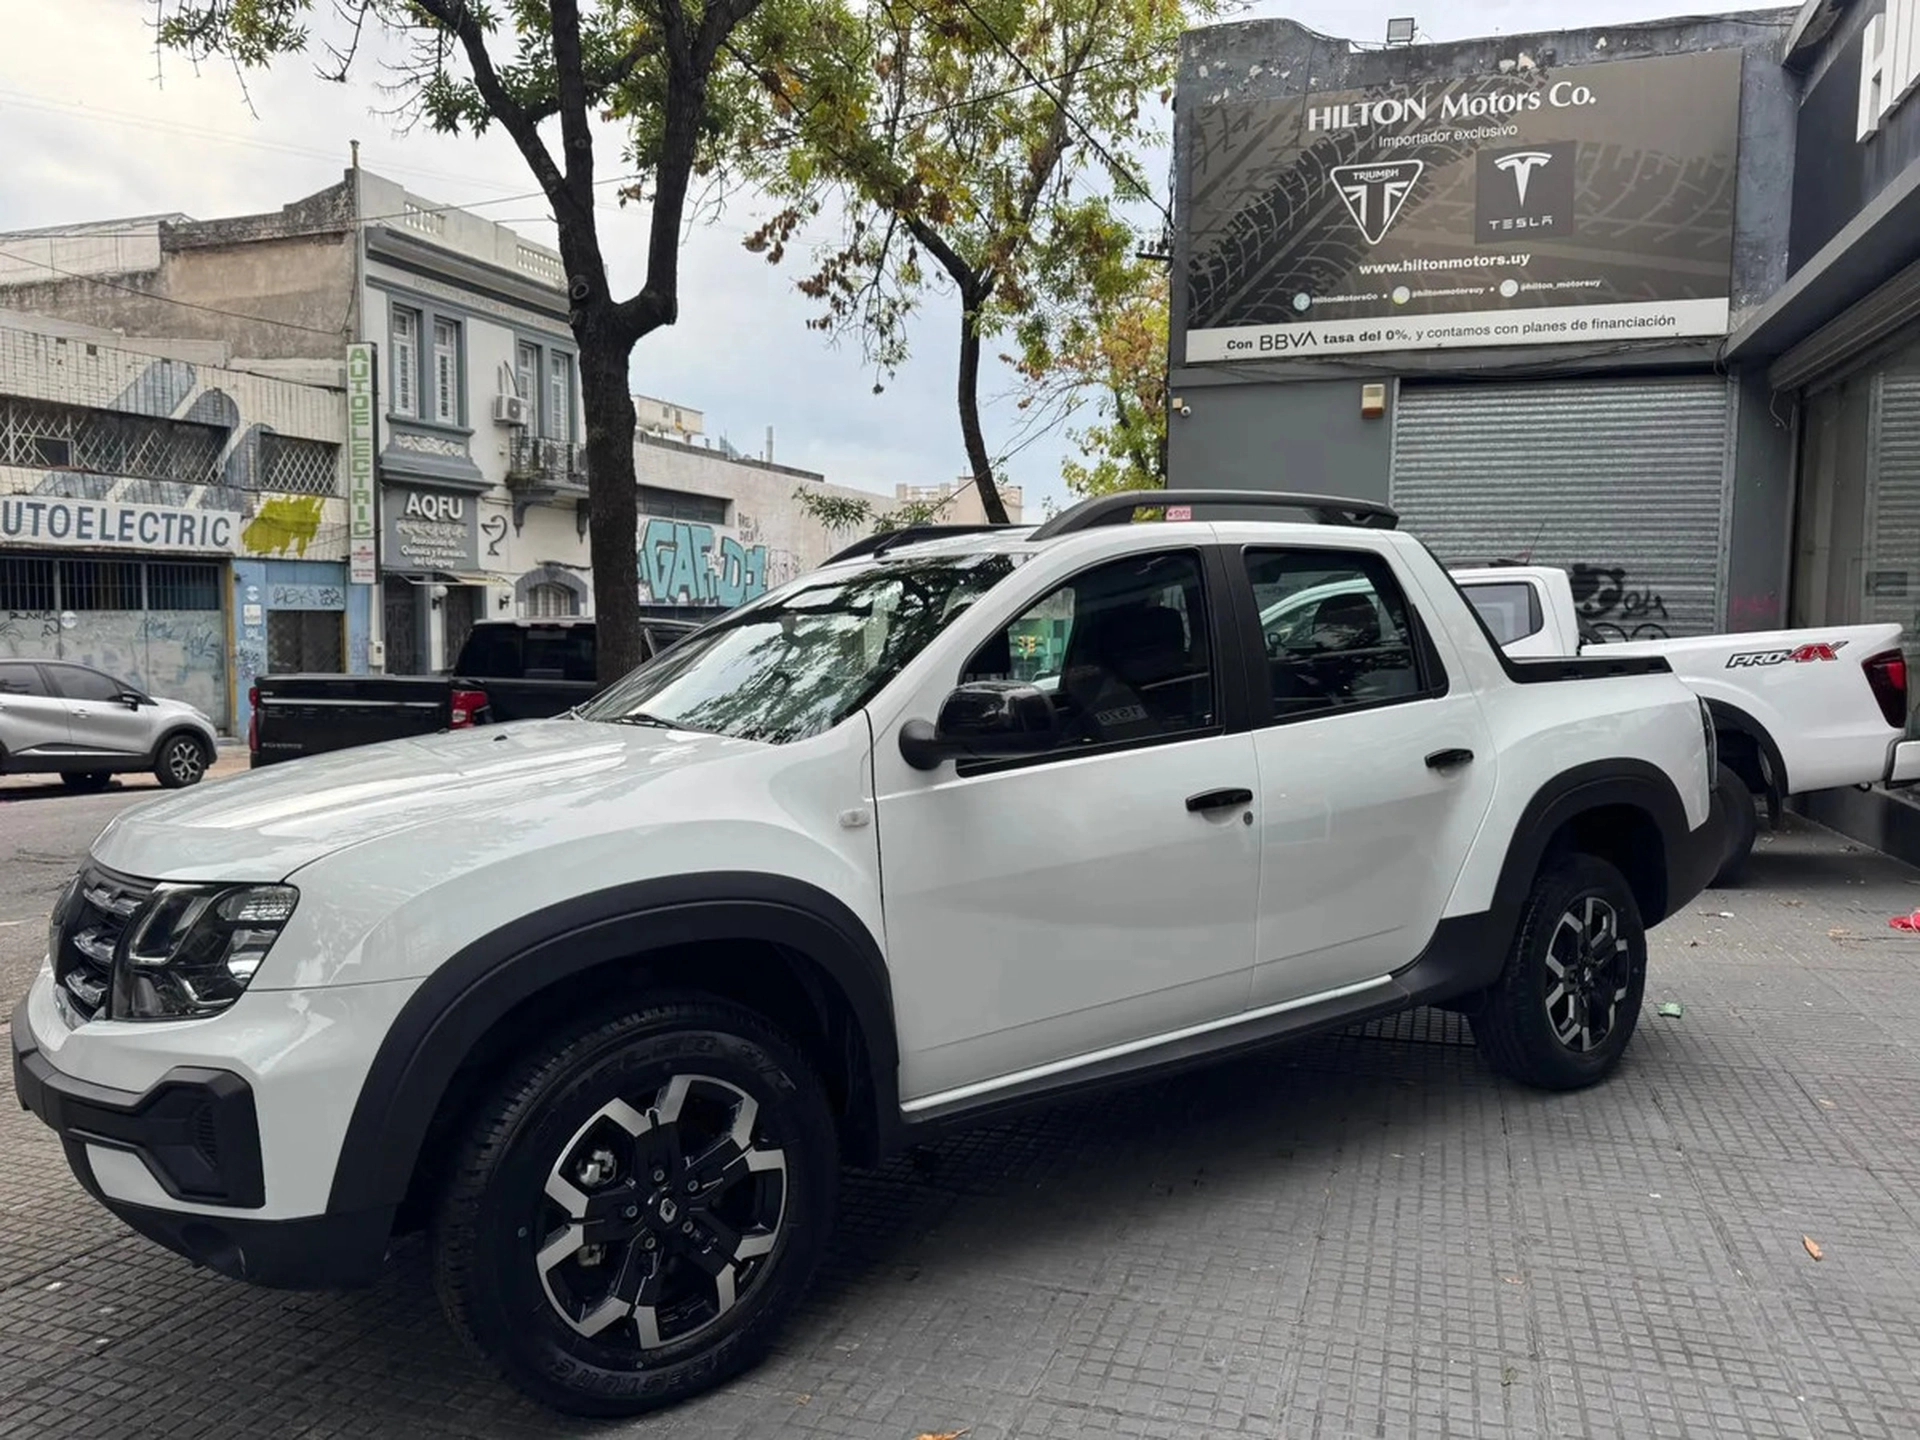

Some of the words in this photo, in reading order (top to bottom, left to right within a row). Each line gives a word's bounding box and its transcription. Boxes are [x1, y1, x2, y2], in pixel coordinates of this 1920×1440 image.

[1308, 97, 1426, 131] HILTON
[1440, 90, 1541, 119] Motors
[1549, 80, 1597, 107] Co.
[1378, 130, 1450, 149] Importador
[1454, 124, 1518, 141] exclusivo
[1353, 168, 1399, 181] TRIUMPH
[1489, 216, 1553, 230] TESLA
[1359, 252, 1531, 275] www.hiltonmotors.uy
[1226, 339, 1252, 351] Con
[1259, 330, 1318, 351] BBVA
[1323, 332, 1354, 344] tasa
[1359, 329, 1382, 342] del
[1386, 328, 1412, 341] 0%,
[1415, 330, 1424, 341] y
[1426, 323, 1490, 338] contamos
[1494, 321, 1519, 334] con
[1522, 316, 1567, 335] planes
[1570, 315, 1588, 331] de
[1591, 312, 1676, 330] financiación
[350, 348, 371, 536] AUTOELECTRIC
[406, 492, 463, 520] AQFU
[1726, 641, 1849, 668] PRO-4X
